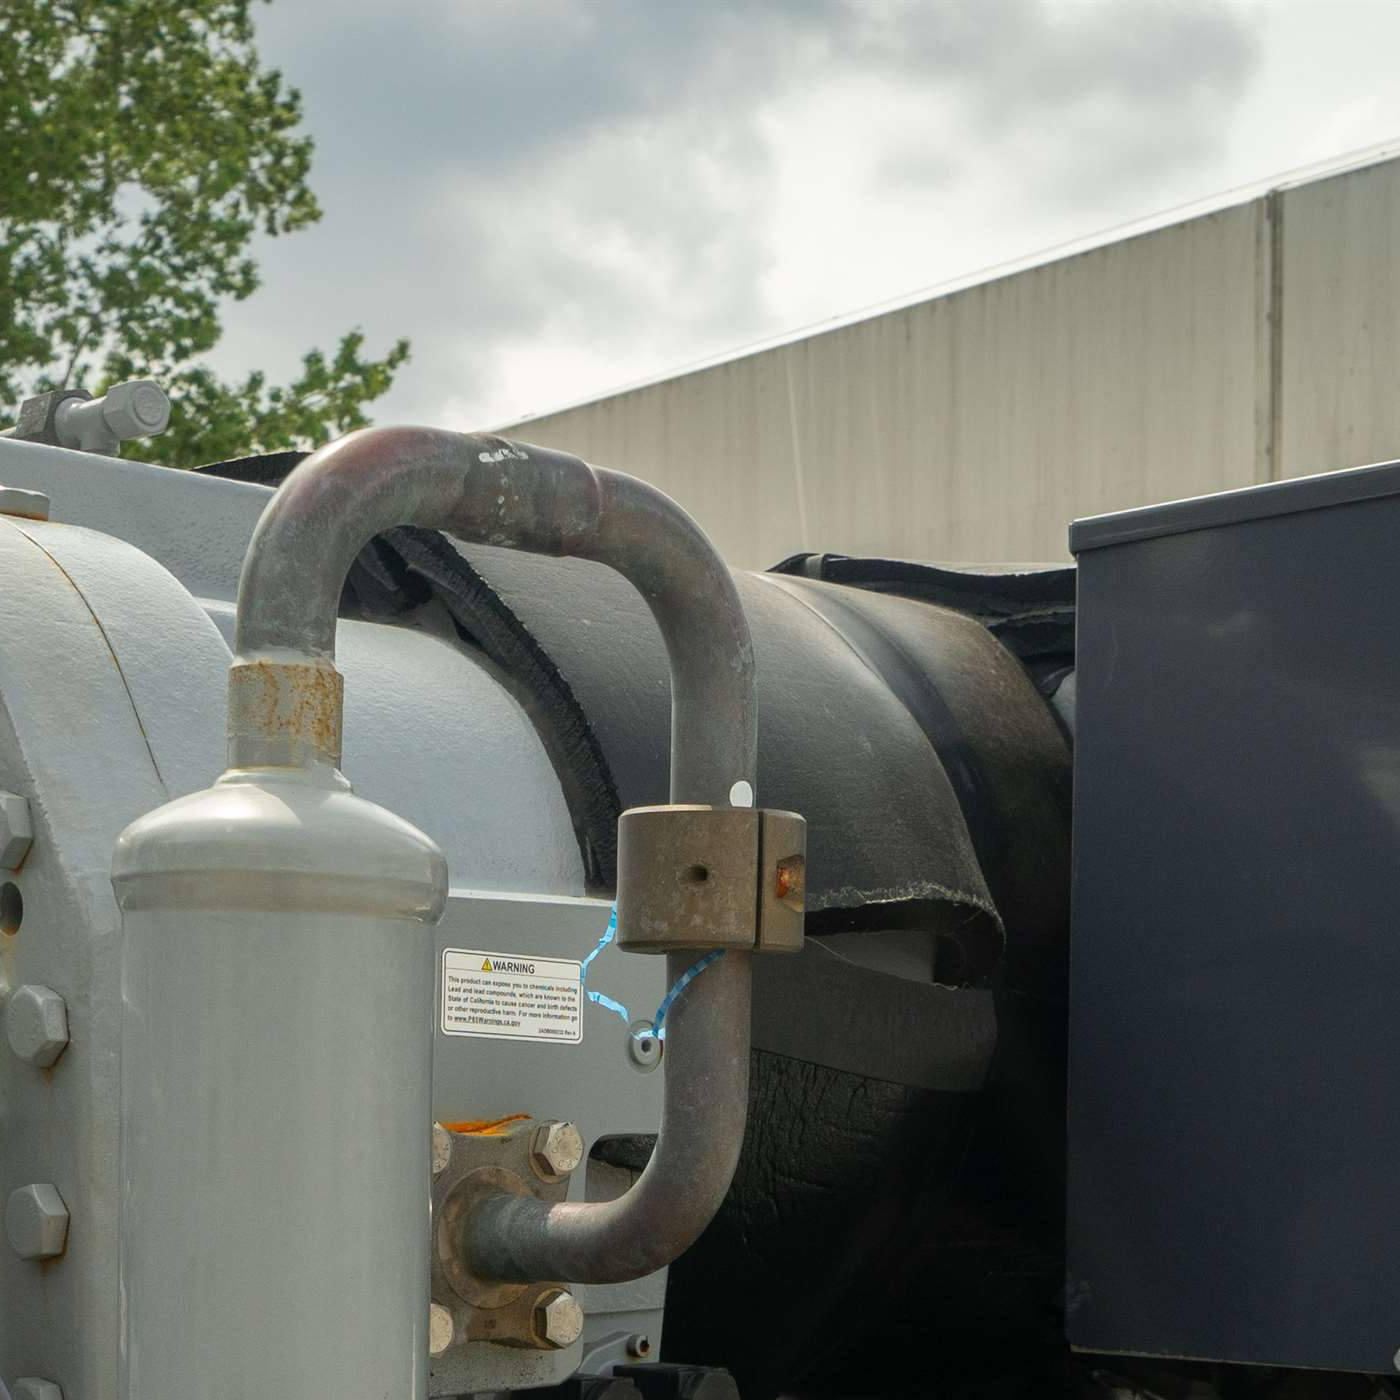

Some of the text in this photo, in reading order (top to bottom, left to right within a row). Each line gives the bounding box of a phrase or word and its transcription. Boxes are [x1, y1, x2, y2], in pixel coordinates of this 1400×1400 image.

[493, 960, 535, 975] WARNING
[448, 976, 459, 984] This
[461, 978, 481, 986] product
[556, 985, 577, 995] including
[469, 1007, 501, 1015] reproductive
[542, 1012, 570, 1020] information
[560, 1004, 578, 1012] defects
